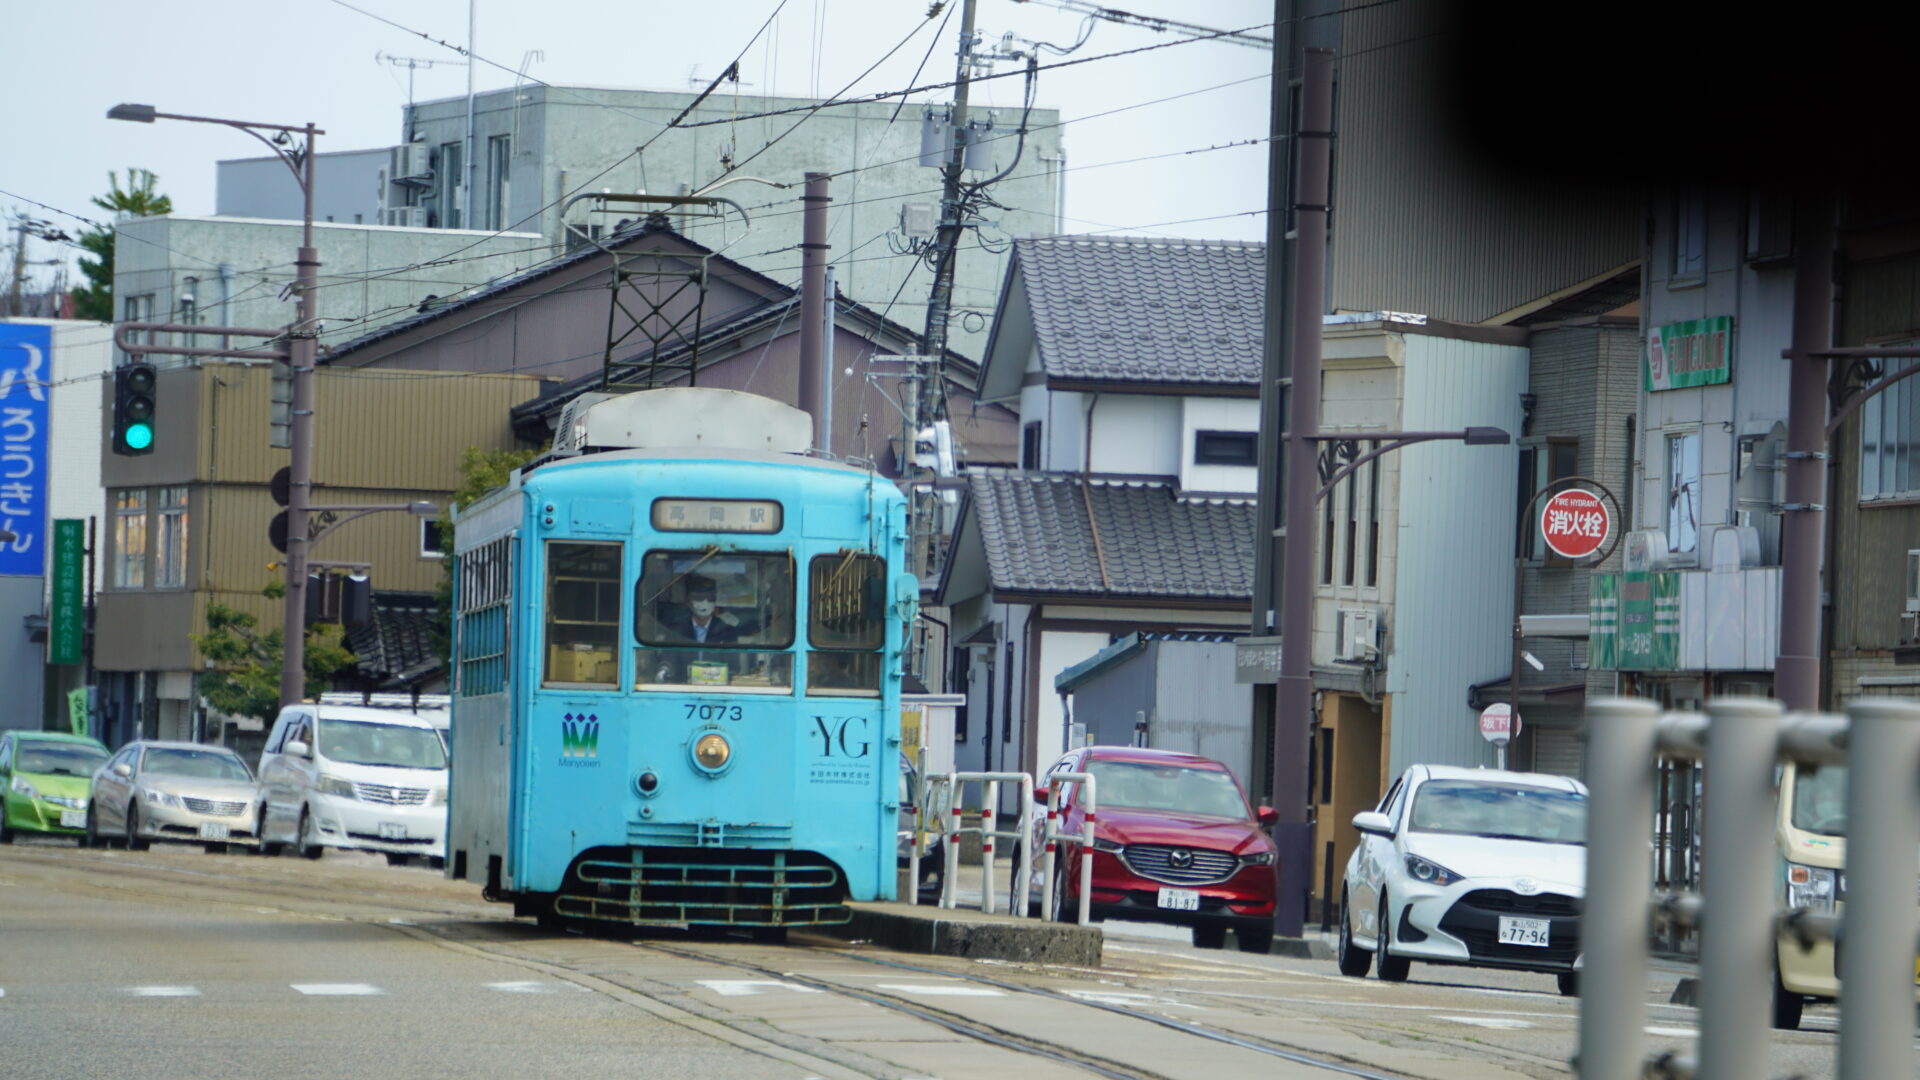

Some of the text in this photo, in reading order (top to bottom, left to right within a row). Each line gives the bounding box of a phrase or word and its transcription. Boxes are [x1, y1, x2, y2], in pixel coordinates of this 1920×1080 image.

[1667, 331, 1725, 375] FUJICOLOR
[0, 407, 36, 554] ろうきん
[1554, 498, 1598, 508] FIRE HYDRANT
[669, 505, 766, 523] 高岡駅
[1548, 510, 1604, 537] 消火栓
[684, 704, 743, 721] 7073
[1482, 716, 1511, 730] 坂下
[810, 715, 872, 759] YG
[1509, 928, 1547, 943] 77-96
